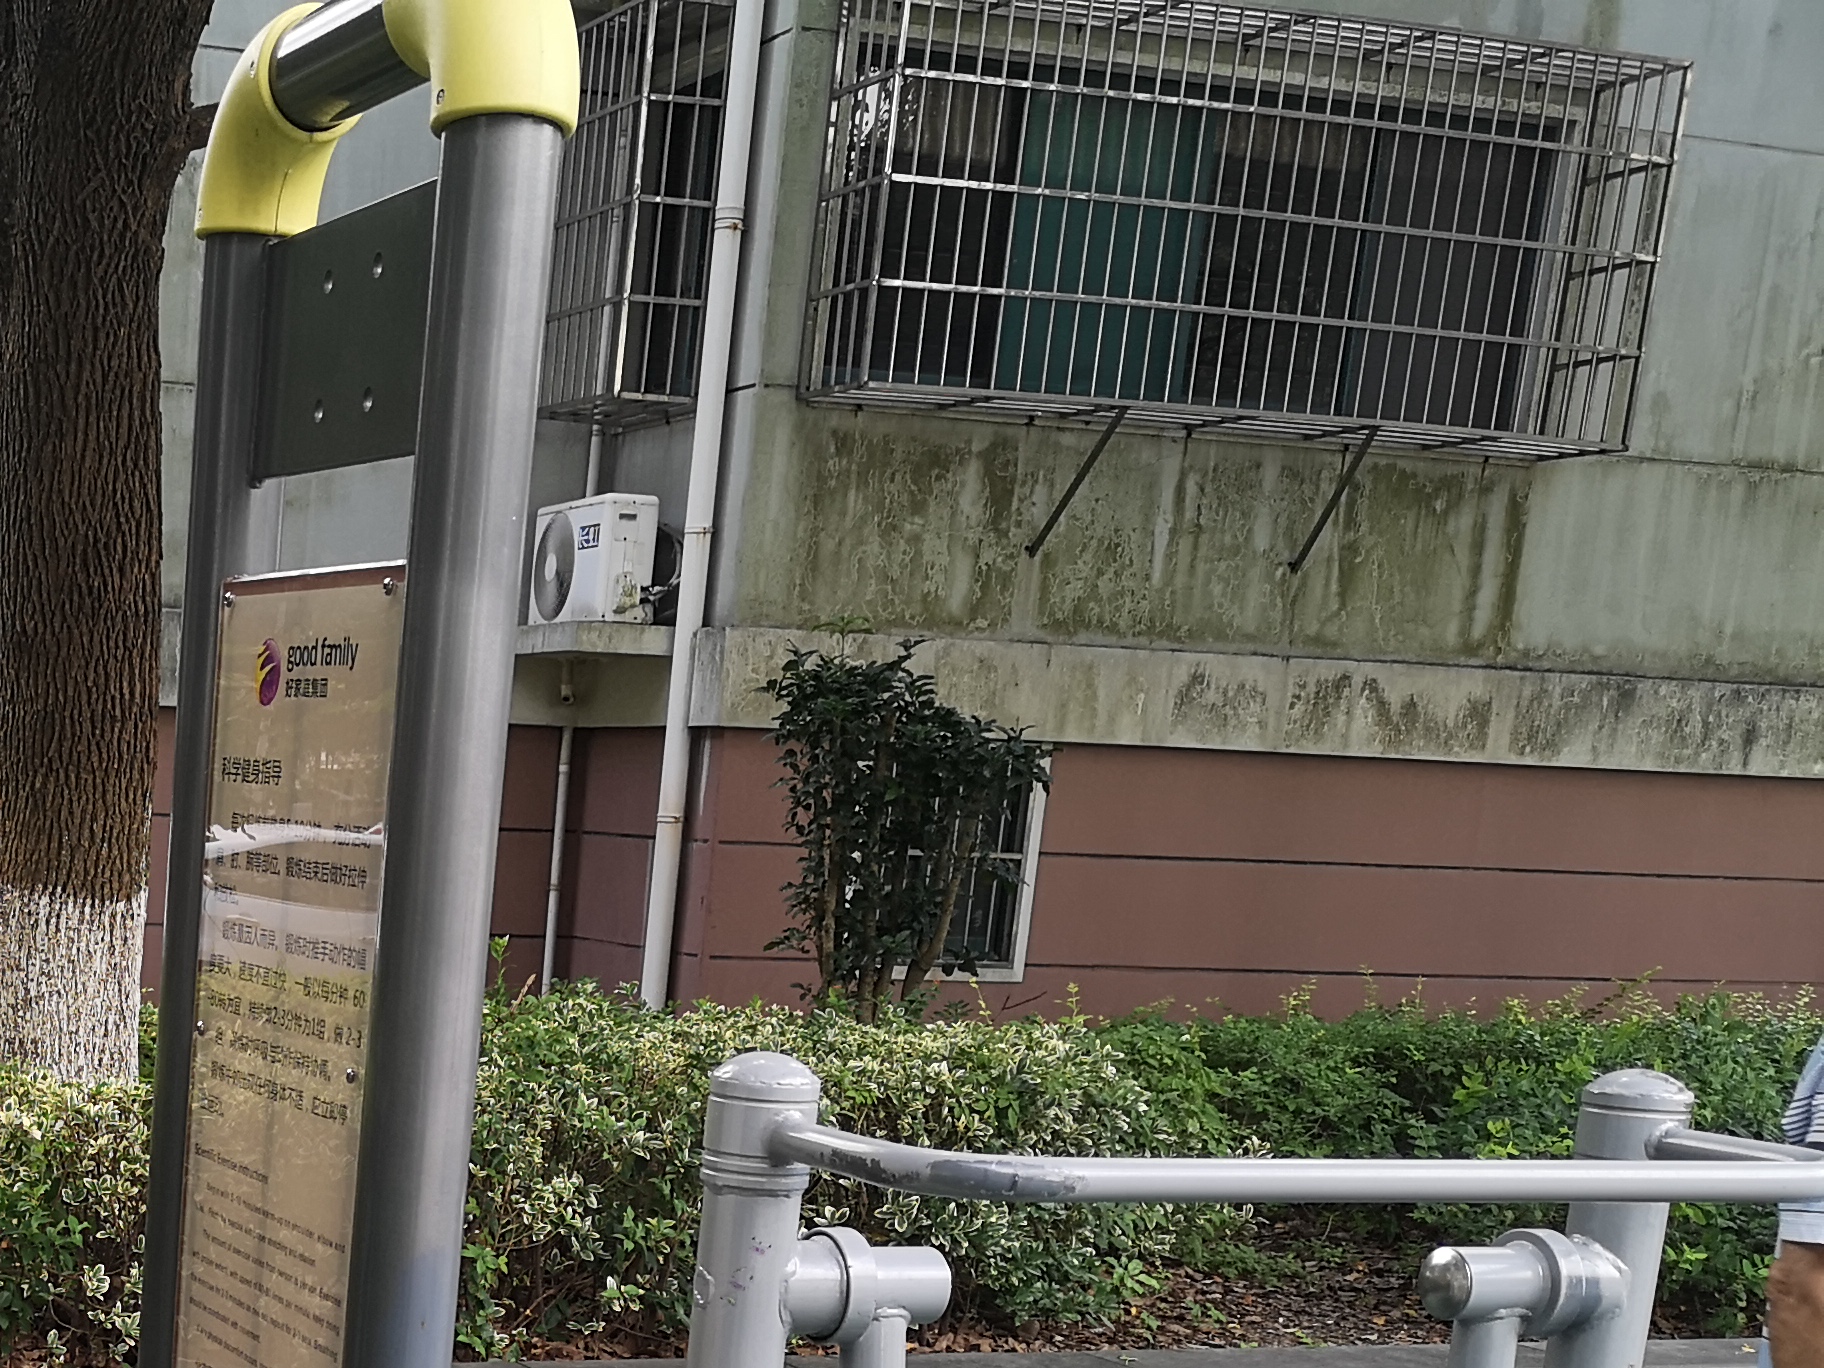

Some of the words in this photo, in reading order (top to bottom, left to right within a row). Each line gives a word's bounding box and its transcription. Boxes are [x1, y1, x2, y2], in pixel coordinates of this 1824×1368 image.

[286, 637, 319, 672] good
[320, 635, 359, 672] family
[285, 678, 328, 699] 好家庭集团
[221, 756, 282, 787] 科学健身指导
